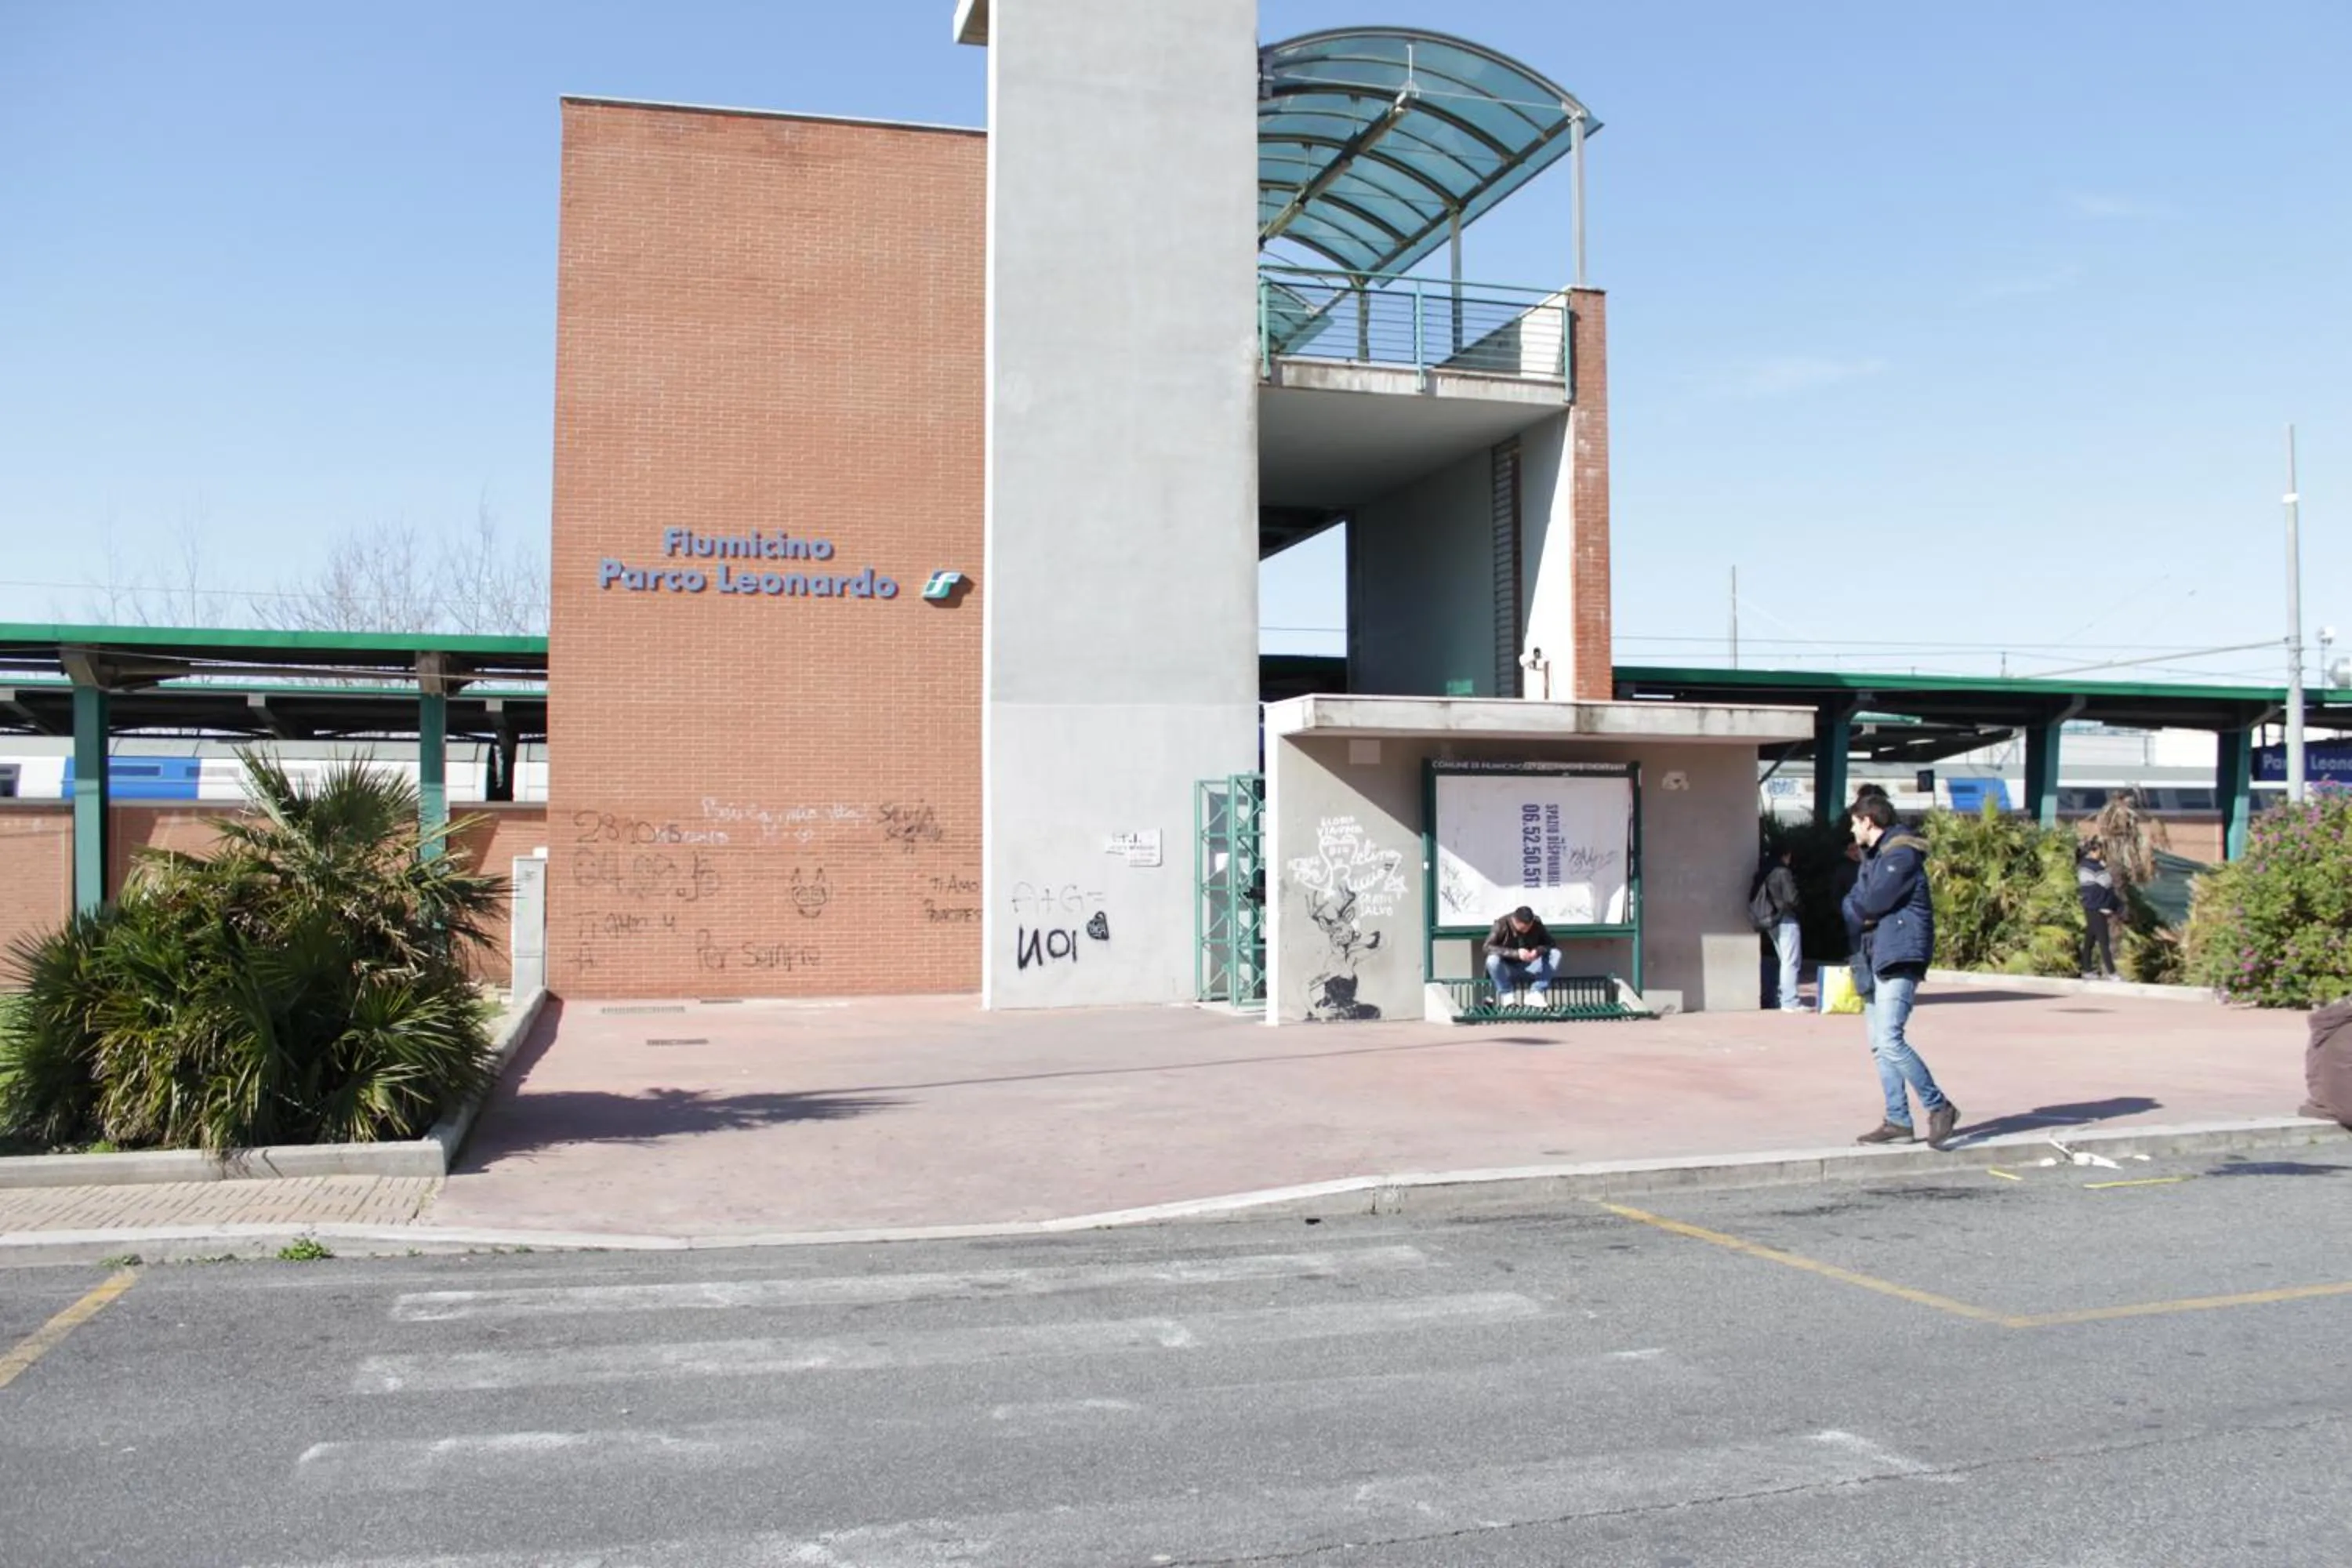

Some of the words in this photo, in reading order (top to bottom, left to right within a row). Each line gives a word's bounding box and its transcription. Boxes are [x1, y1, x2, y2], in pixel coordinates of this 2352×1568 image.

[663, 527, 834, 561] Fiumicino
[599, 558, 706, 591] Parco
[717, 563, 898, 599] Leonardo
[1432, 760, 1469, 769] COMUNE
[1545, 804, 1559, 833] SPAZIO
[1522, 804, 1541, 888] 06.52.50.511
